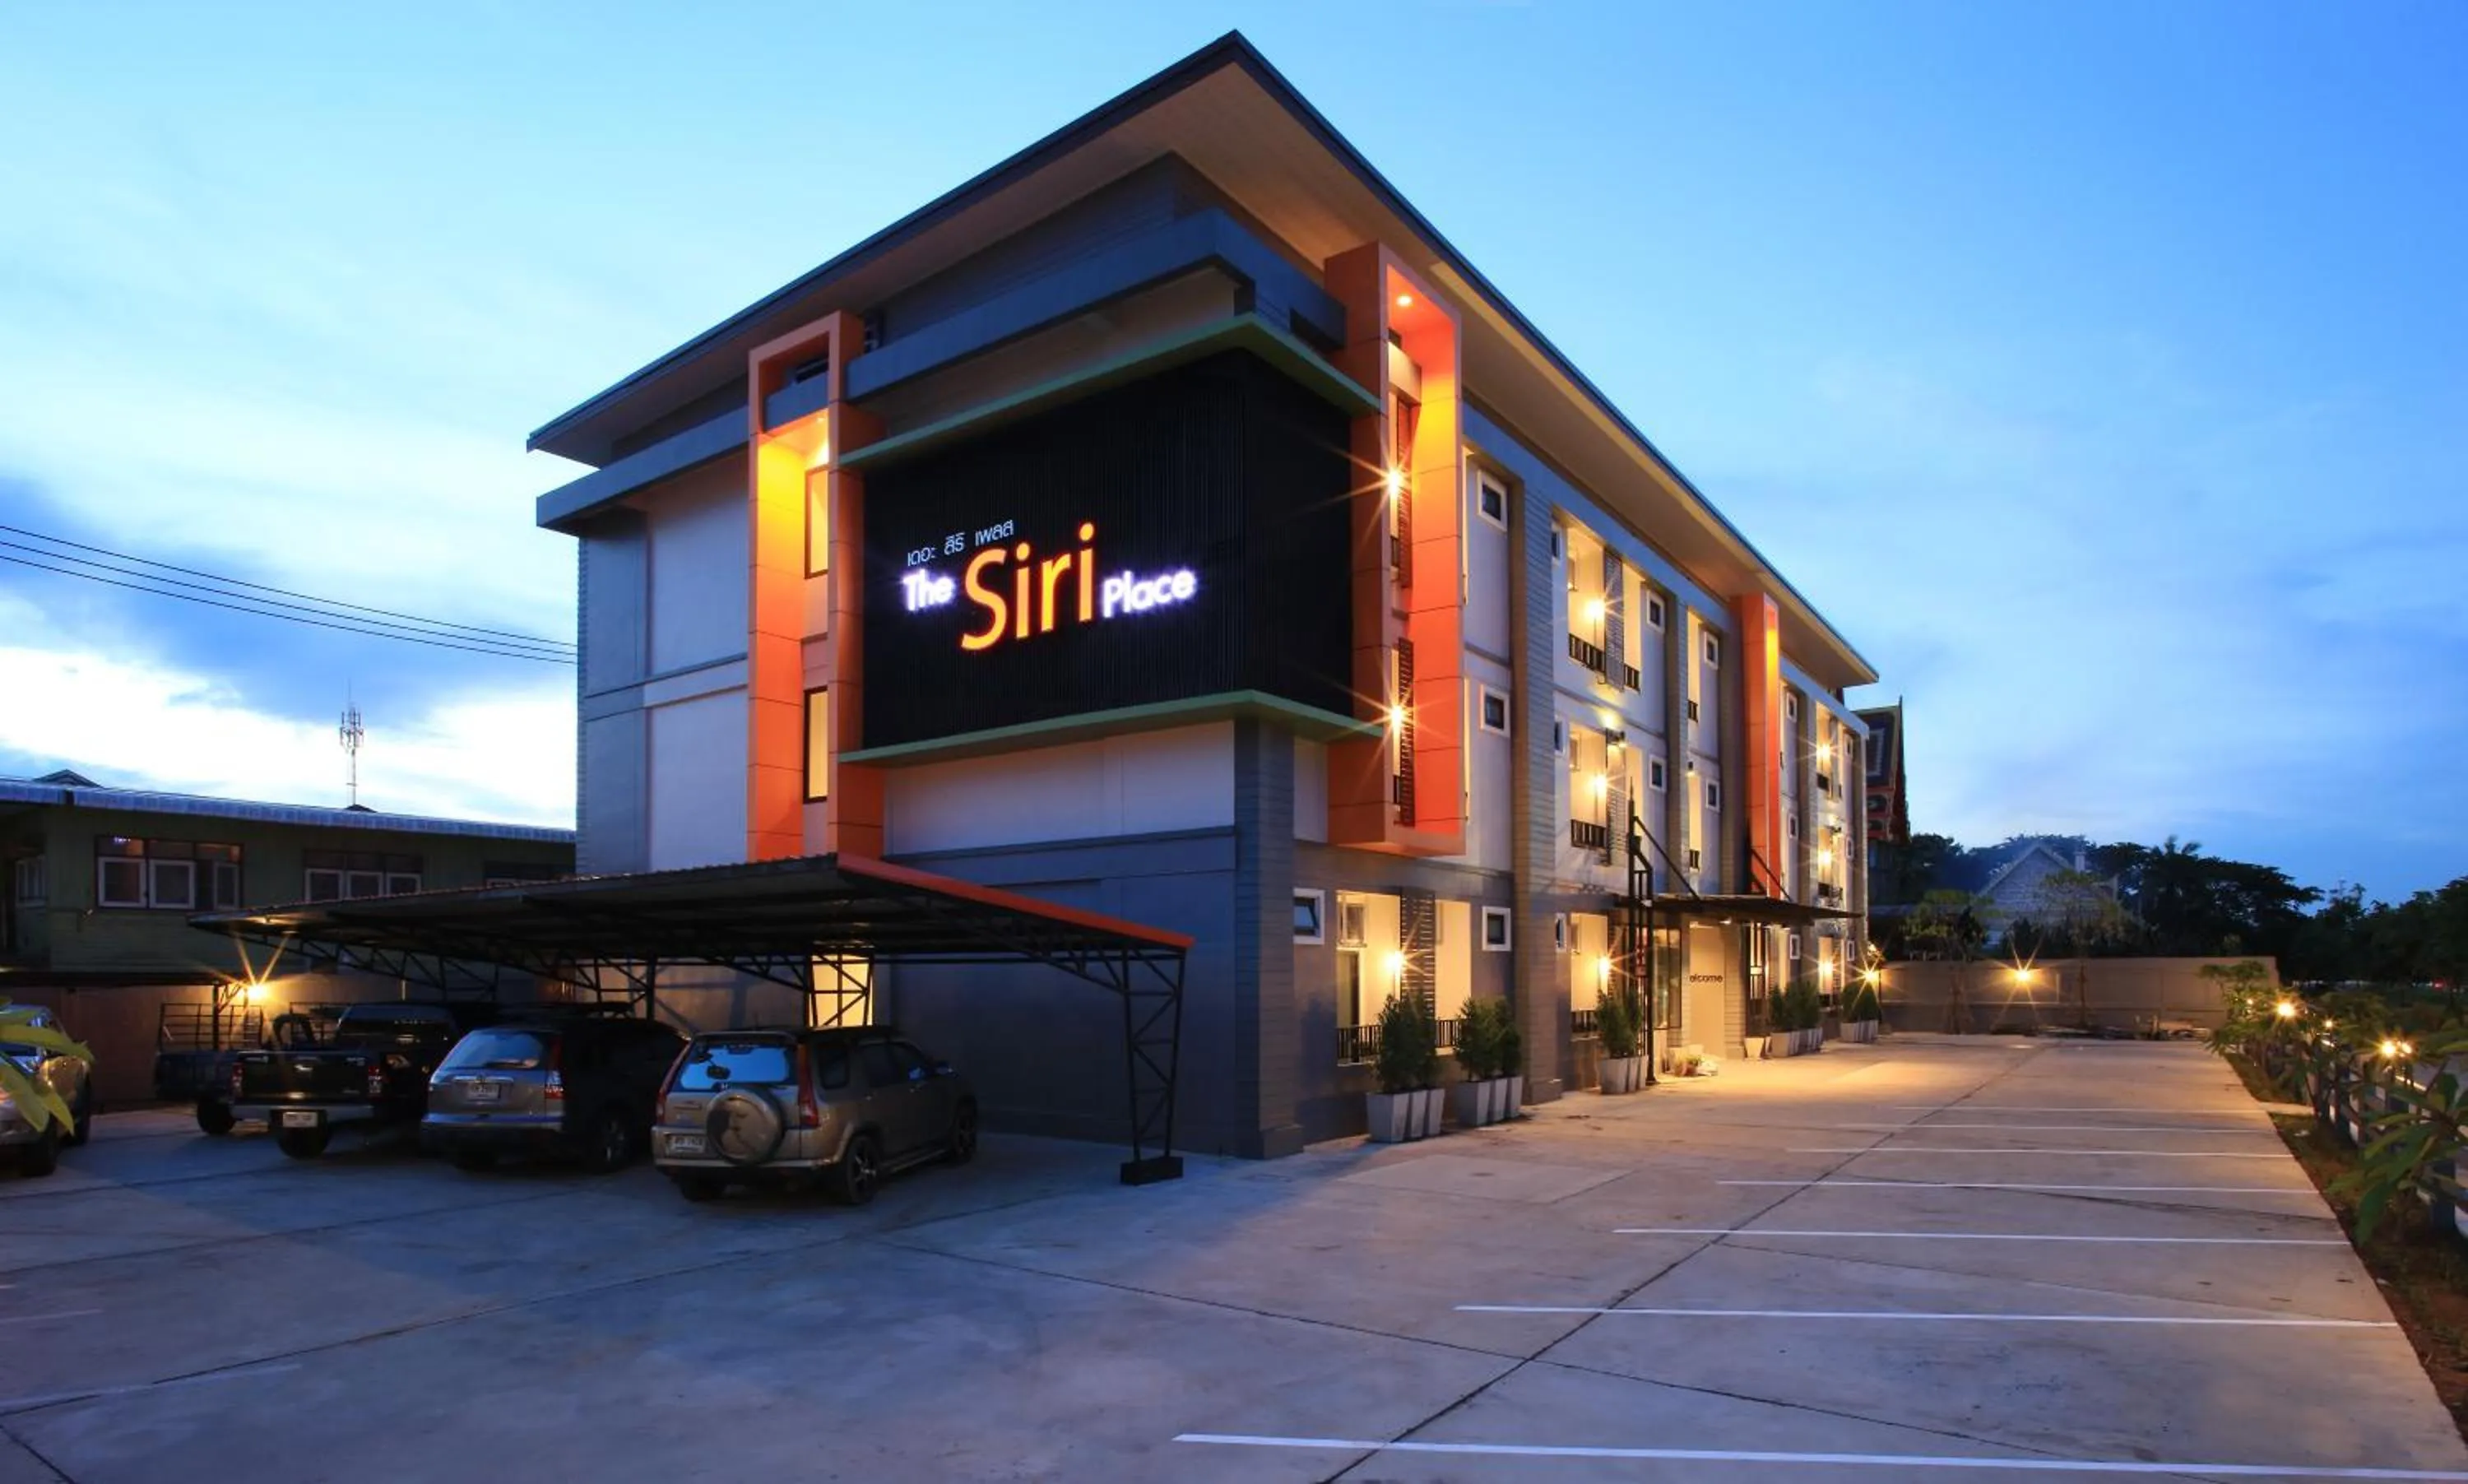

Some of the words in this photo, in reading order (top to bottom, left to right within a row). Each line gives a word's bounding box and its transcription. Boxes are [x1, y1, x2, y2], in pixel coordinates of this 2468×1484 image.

[902, 569, 955, 611] The
[960, 522, 1095, 651] Siri
[1102, 569, 1196, 619] Place
[907, 546, 937, 567] เดอะ
